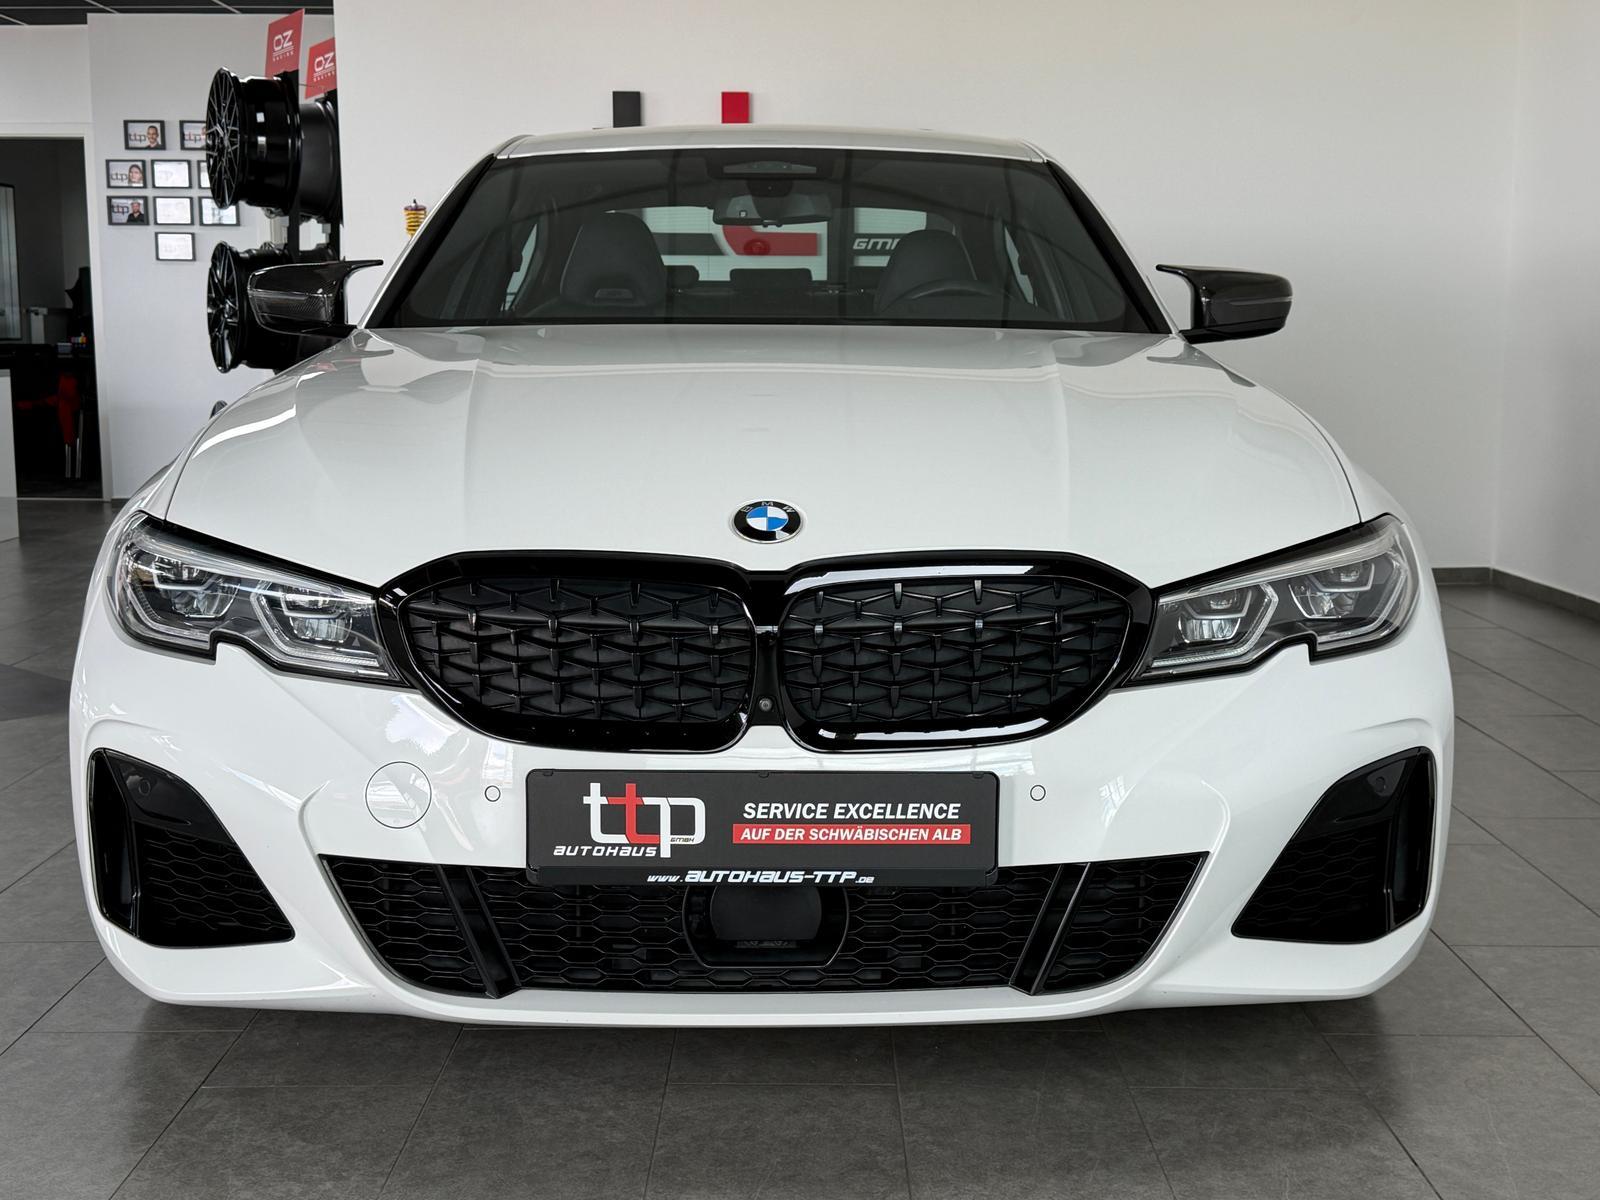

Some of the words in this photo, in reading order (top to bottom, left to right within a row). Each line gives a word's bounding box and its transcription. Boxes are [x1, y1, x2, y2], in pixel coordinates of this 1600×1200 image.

[273, 29, 294, 51] OZ
[314, 51, 335, 72] OZ
[740, 501, 796, 513] BMW
[743, 803, 829, 819] SERVICE
[833, 803, 961, 820] EXCELLENCE
[583, 783, 706, 858] ttp
[740, 828, 771, 840] AUF
[774, 828, 807, 840] DER
[809, 826, 929, 841] SCHWÄBISCHEN
[932, 828, 962, 841] ALB
[553, 845, 657, 857] AUTOHAUS
